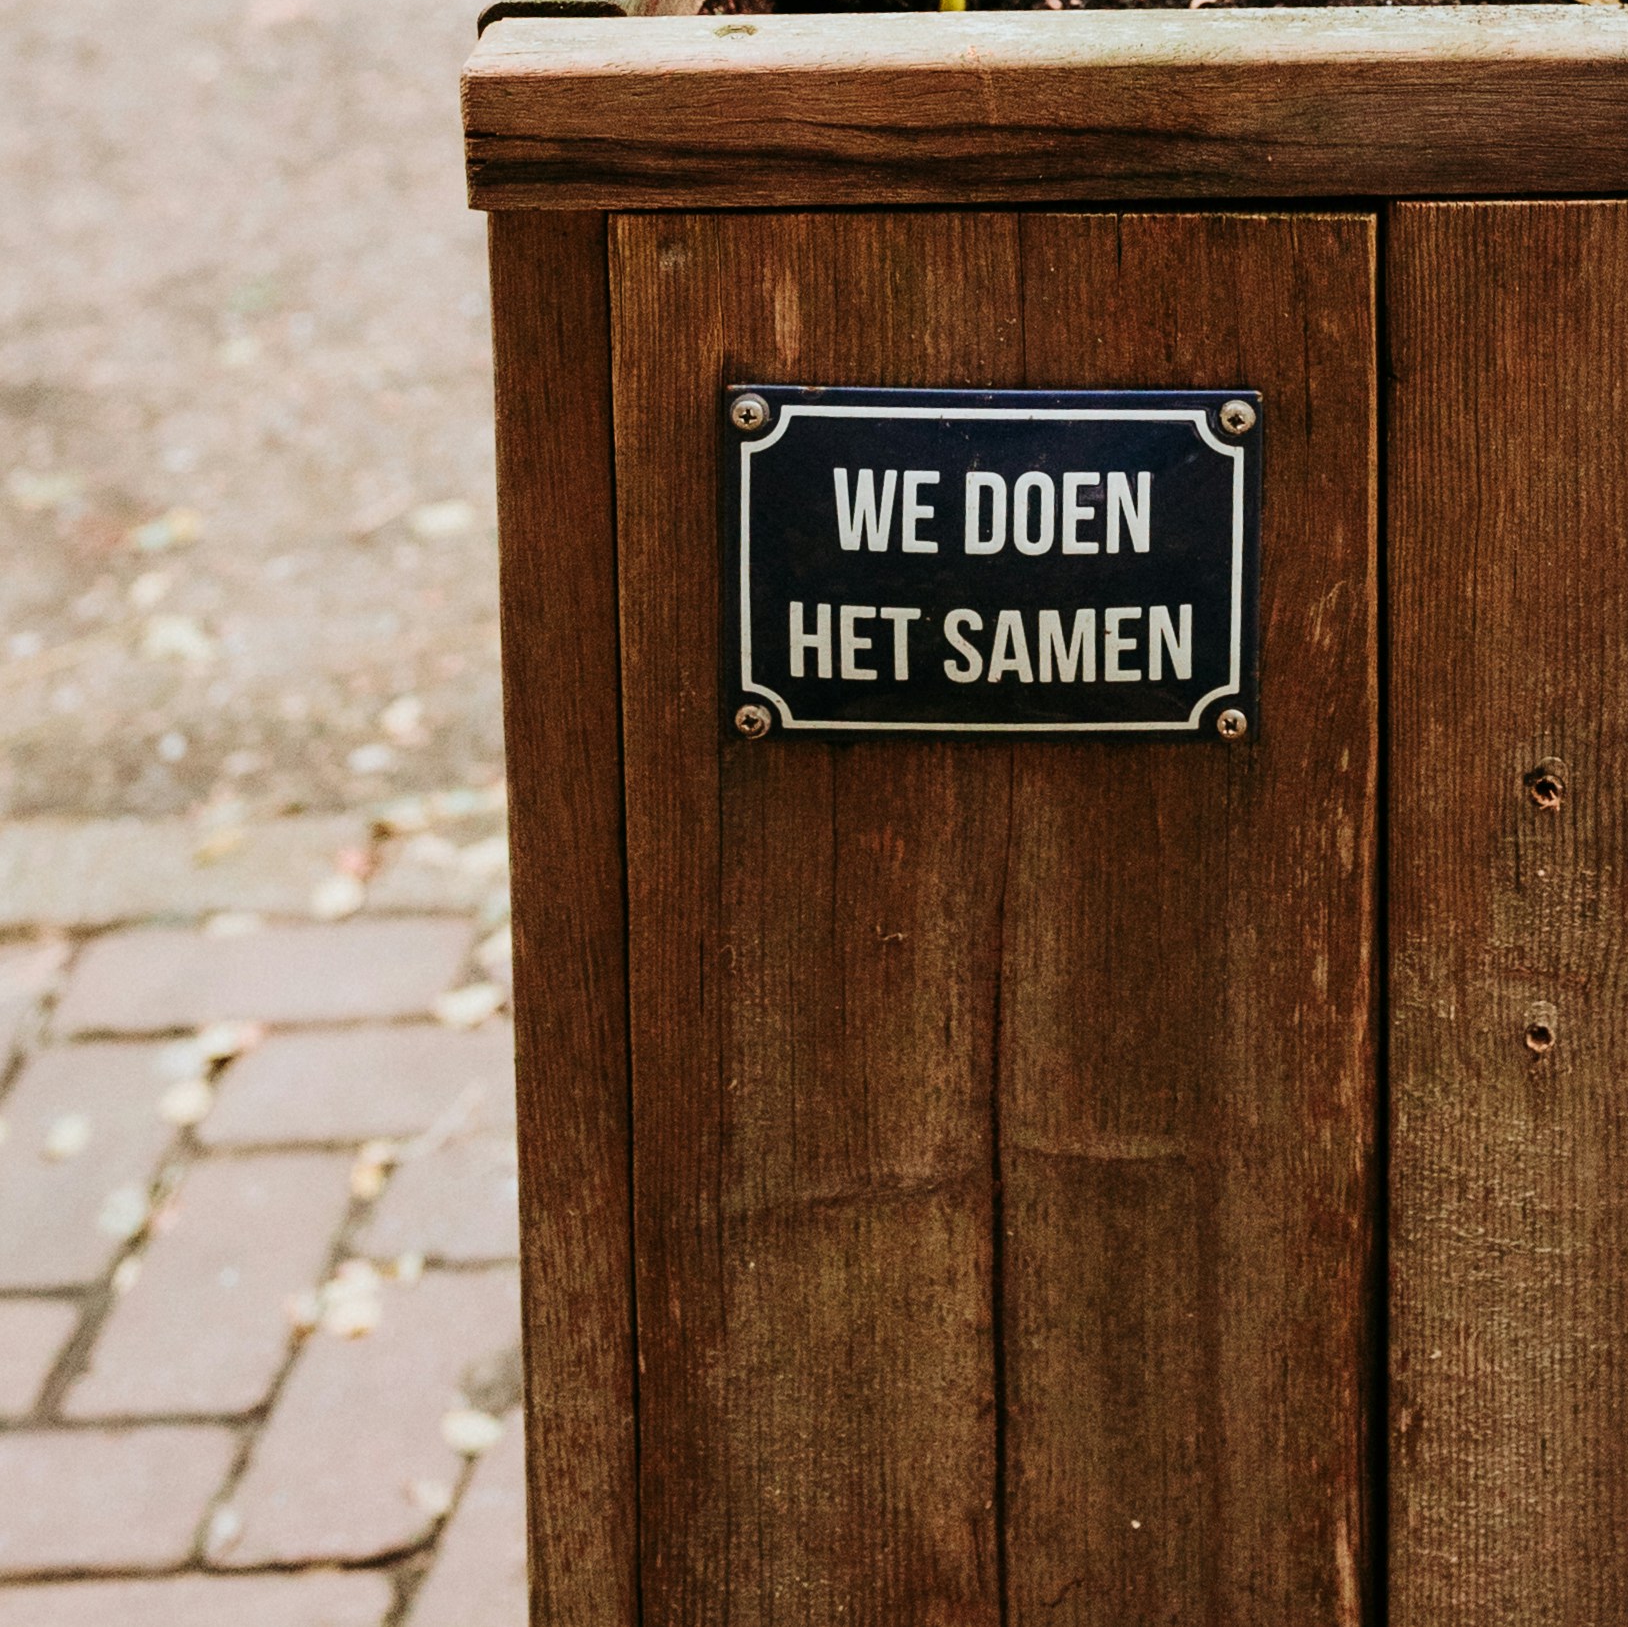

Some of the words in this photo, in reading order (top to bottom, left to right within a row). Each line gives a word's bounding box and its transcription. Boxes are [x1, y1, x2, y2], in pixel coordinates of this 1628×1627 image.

[834, 468, 940, 552] WE
[965, 471, 1151, 555] DOEN
[791, 602, 920, 679] HET
[945, 605, 1191, 682] SAMEN
